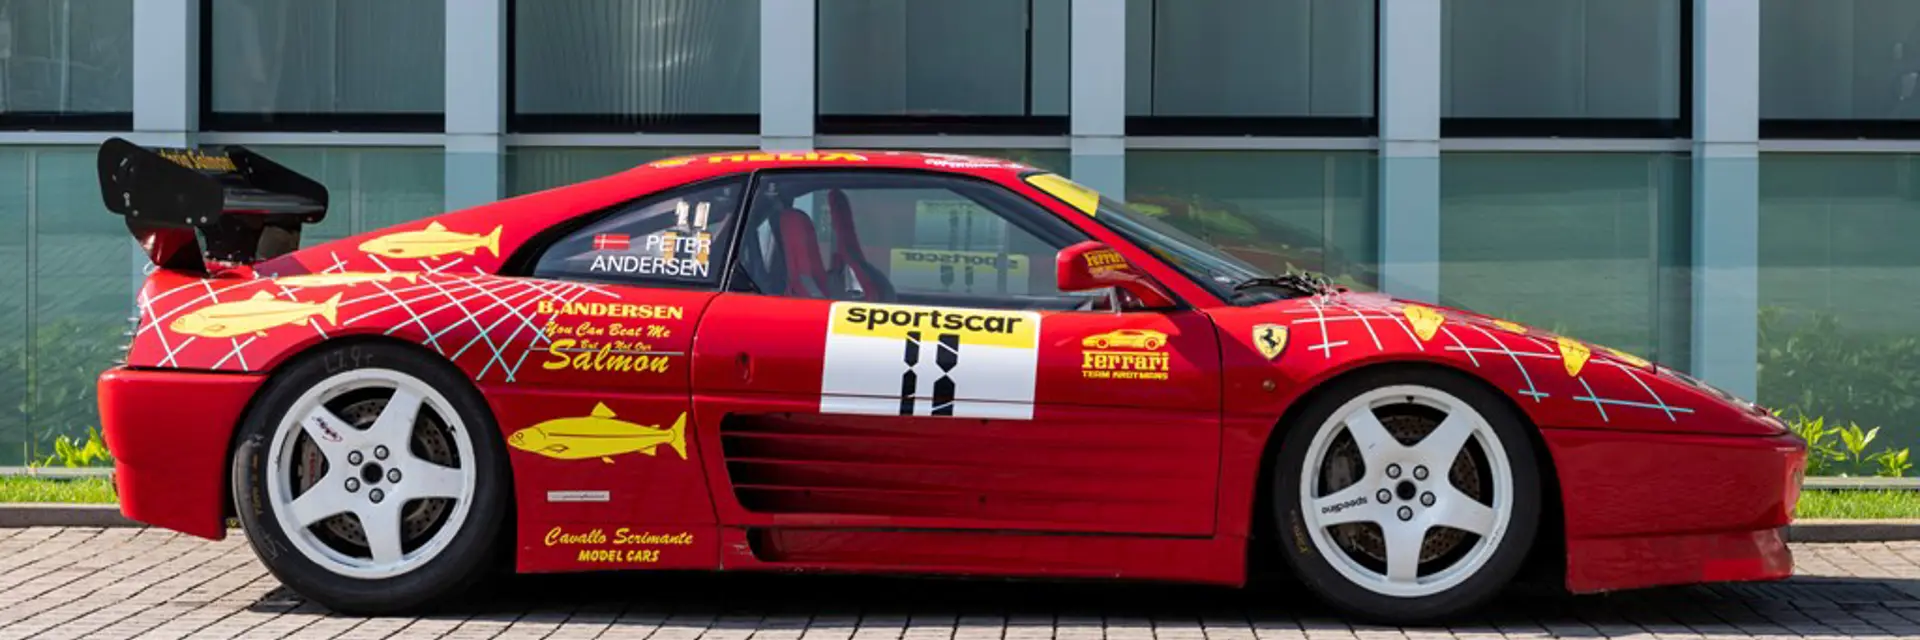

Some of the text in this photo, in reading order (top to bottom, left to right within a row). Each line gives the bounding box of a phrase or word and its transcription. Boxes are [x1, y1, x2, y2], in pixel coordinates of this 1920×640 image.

[645, 233, 711, 255] PETER
[590, 254, 711, 277] ANDERSEN
[537, 300, 683, 319] B.ANDERSEN
[845, 306, 1022, 334] sportscar
[545, 320, 671, 338] You Can Beat Me
[542, 338, 669, 373] Salmon
[1082, 350, 1170, 371] Ferrari
[899, 331, 960, 416] 11
[544, 526, 694, 546] Cavallo Scrimante
[577, 549, 660, 563] MODEL CARS
